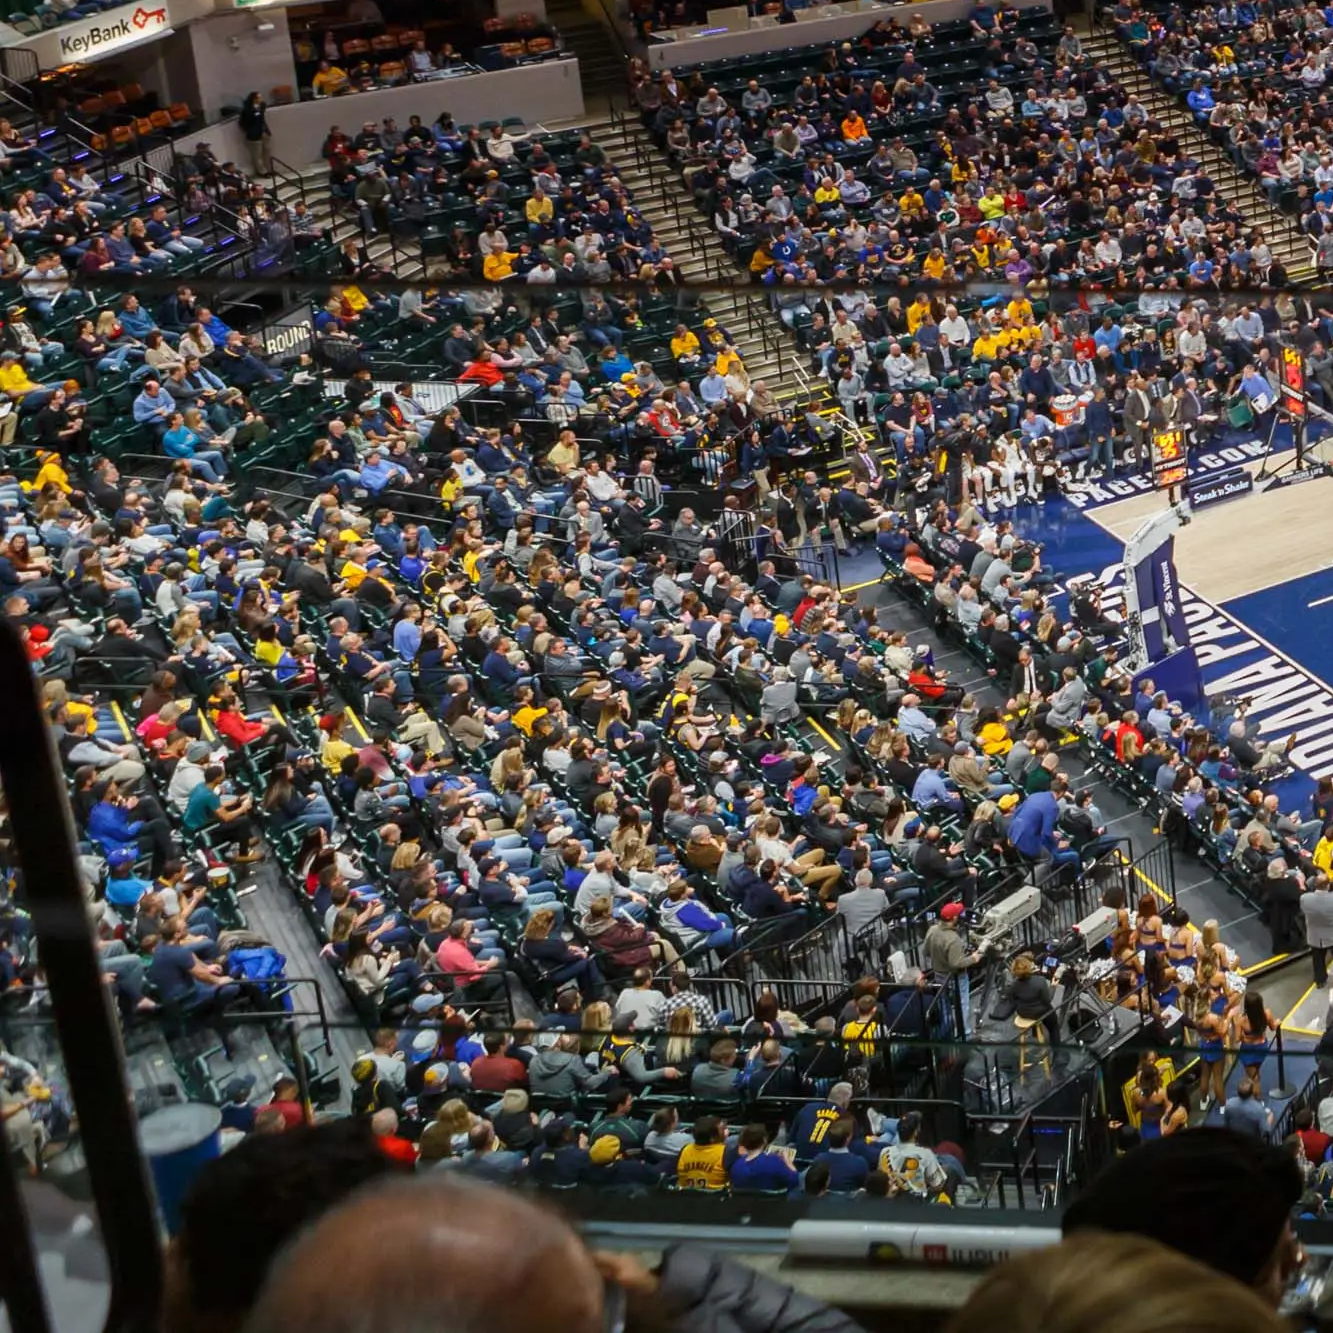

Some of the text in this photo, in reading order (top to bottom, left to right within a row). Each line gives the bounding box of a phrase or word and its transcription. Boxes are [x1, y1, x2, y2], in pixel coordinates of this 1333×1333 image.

[61, 18, 132, 54] KeyBank
[1193, 480, 1250, 504] Steak Shake
